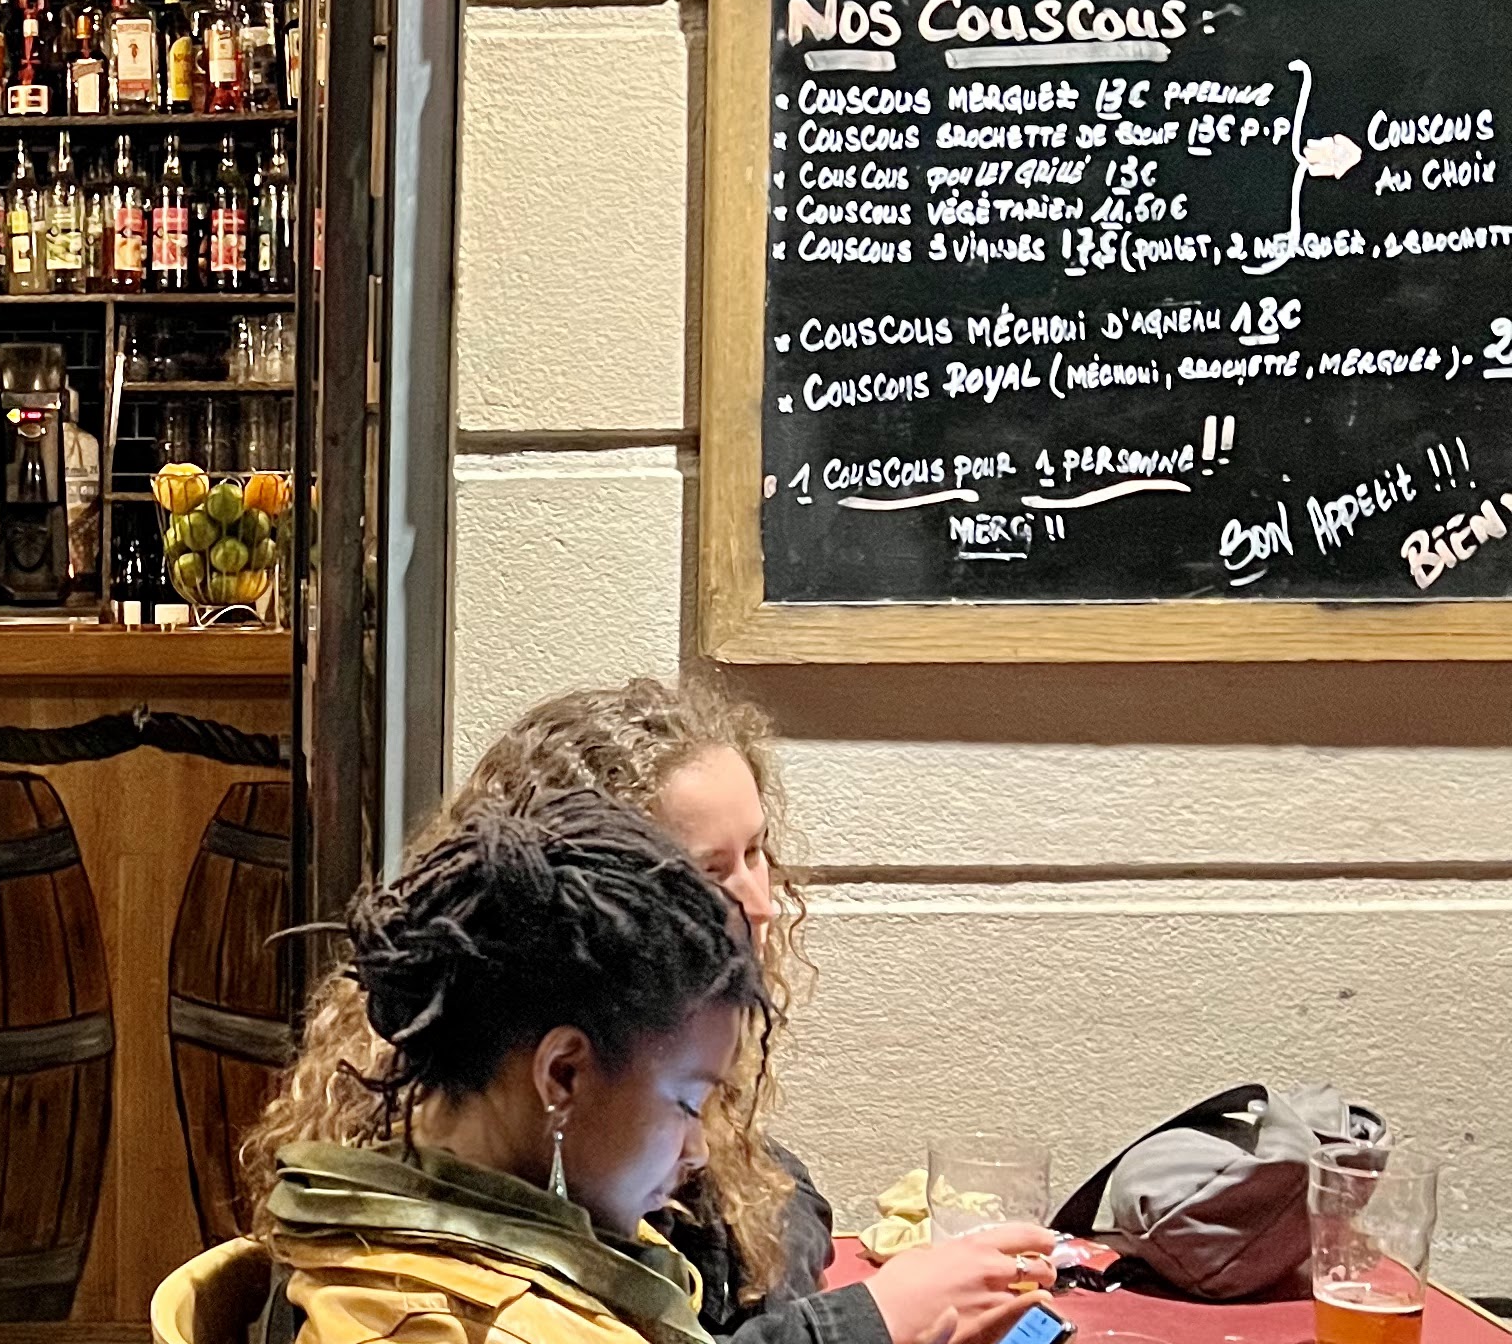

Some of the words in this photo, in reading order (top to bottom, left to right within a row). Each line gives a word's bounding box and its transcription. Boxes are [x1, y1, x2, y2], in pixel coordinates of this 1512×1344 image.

[798, 79, 932, 115] COUSCOUS
[798, 119, 920, 154] COUSCOUS
[1075, 122, 1107, 150] DE
[1367, 109, 1495, 152] COUSCOUS
[796, 194, 912, 225] COUSCOUS
[797, 230, 913, 264] COUSCOUS
[799, 316, 953, 352] COUSCOUS
[1231, 297, 1302, 335] 18€
[802, 370, 930, 412] COUSCOUS
[942, 358, 1041, 404] ROYAL
[823, 457, 946, 490] COUSCOUS
